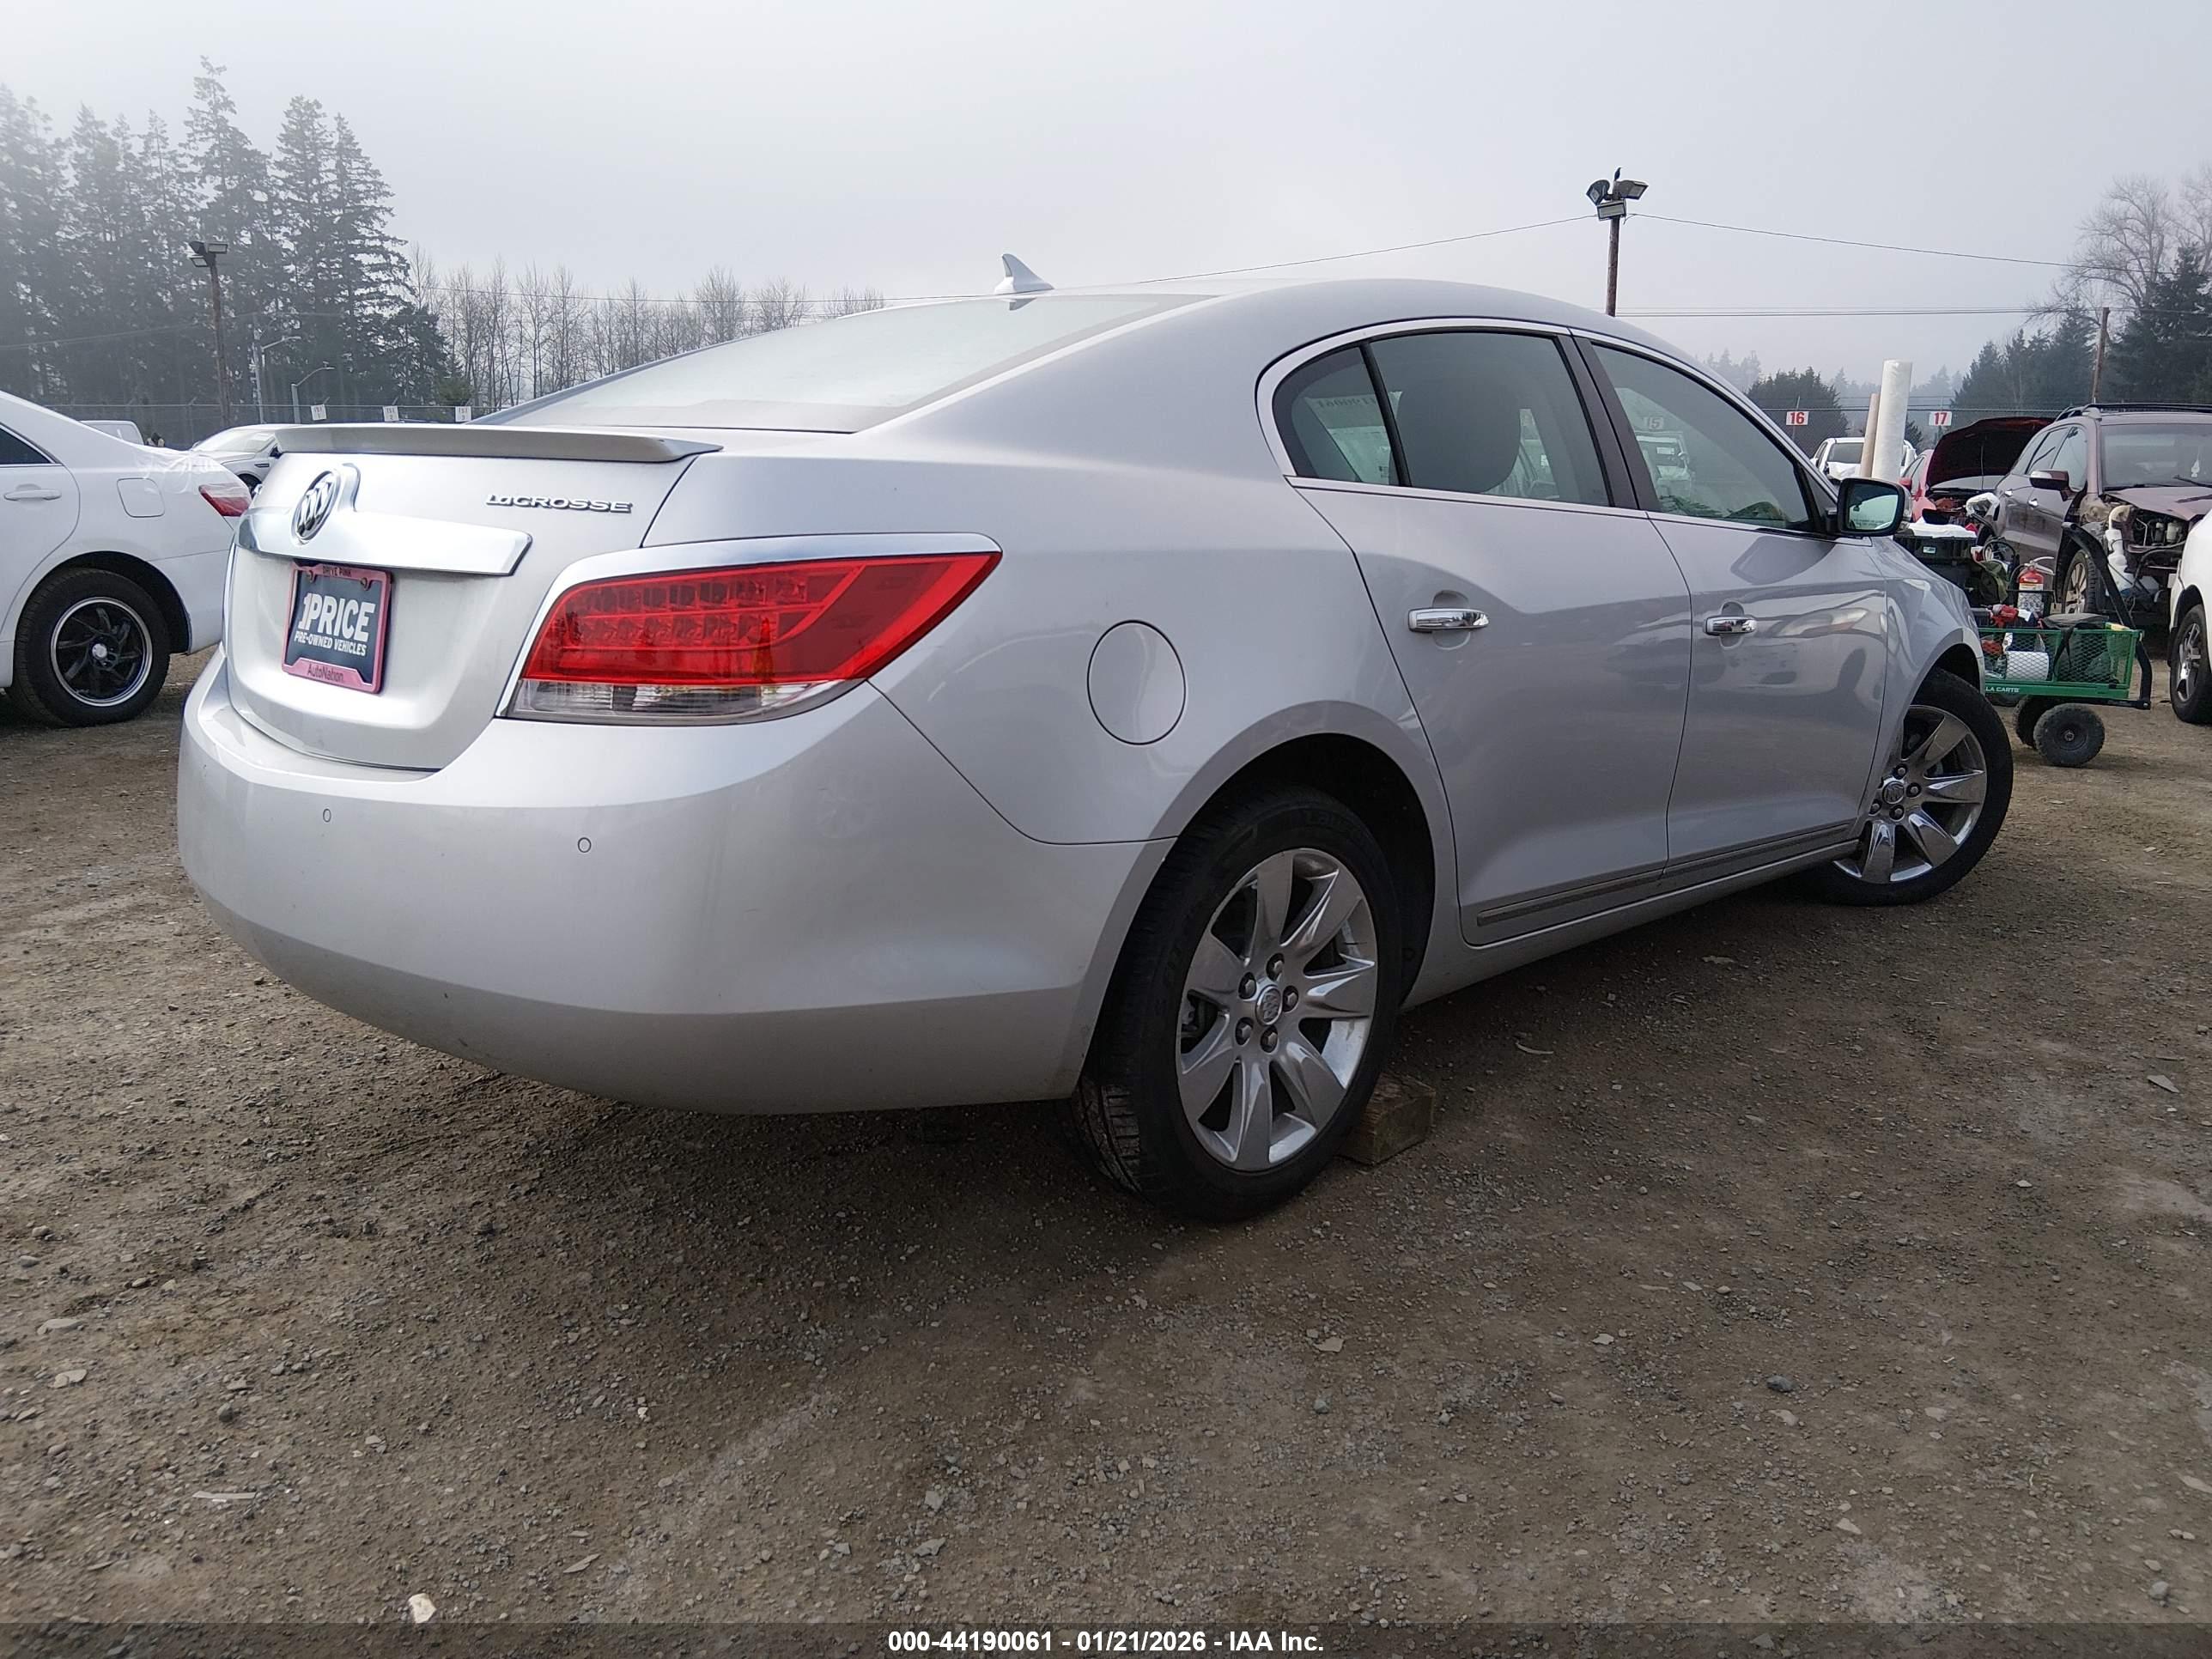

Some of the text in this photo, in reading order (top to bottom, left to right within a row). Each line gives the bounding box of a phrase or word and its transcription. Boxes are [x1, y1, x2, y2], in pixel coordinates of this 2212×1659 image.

[1790, 412, 1805, 424] 16
[1934, 412, 1948, 425] 17
[294, 630, 368, 657] PRE-OWNED VEHICLES
[307, 663, 344, 684] AutoNation
